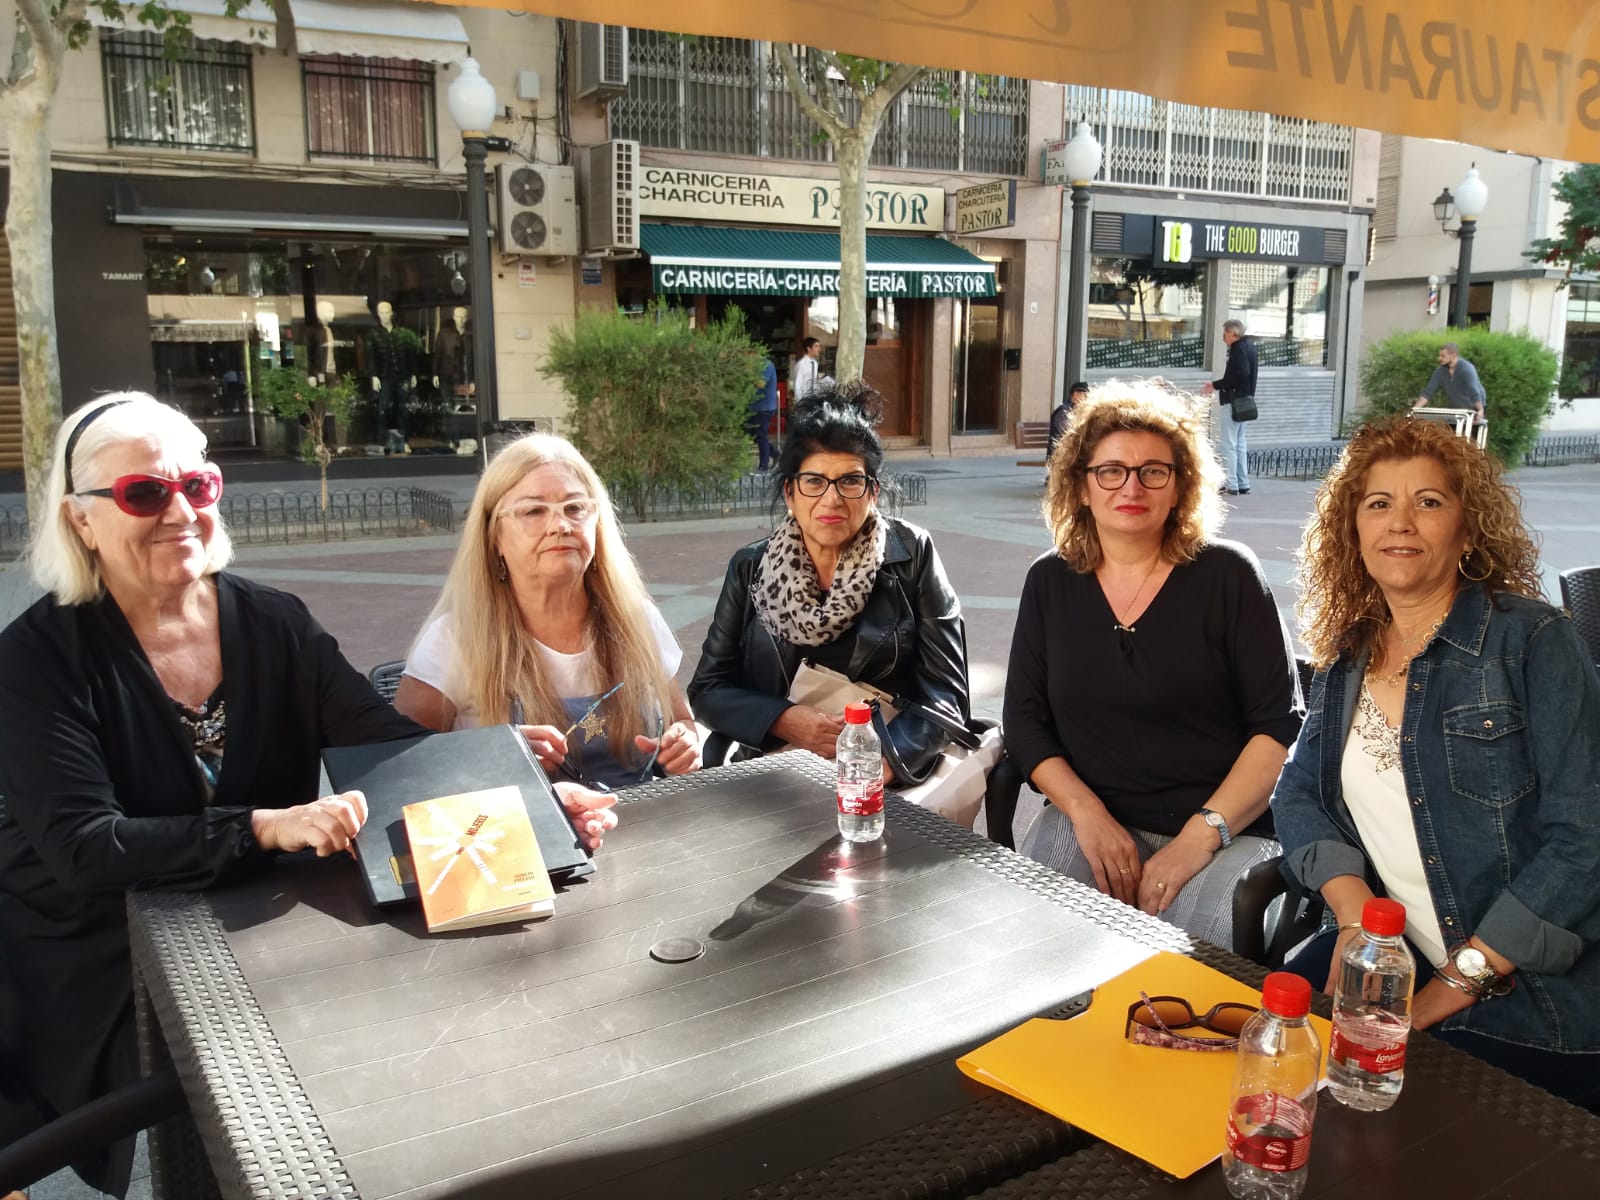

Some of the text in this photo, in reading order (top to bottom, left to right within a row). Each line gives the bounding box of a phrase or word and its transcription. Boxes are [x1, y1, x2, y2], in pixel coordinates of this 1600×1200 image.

[646, 169, 771, 192] CARNICERIA
[962, 183, 1003, 199] CARNICERIA
[639, 185, 785, 209] CHARCUTERIA
[958, 192, 1006, 209] CHARCUTERIA
[961, 208, 1002, 231] PASTOR
[1205, 224, 1300, 257] THE GOOD BURGER
[102, 272, 144, 281] TAMARIT
[660, 268, 987, 294] CARNICERÍA-CHARERÍA PASTOR
